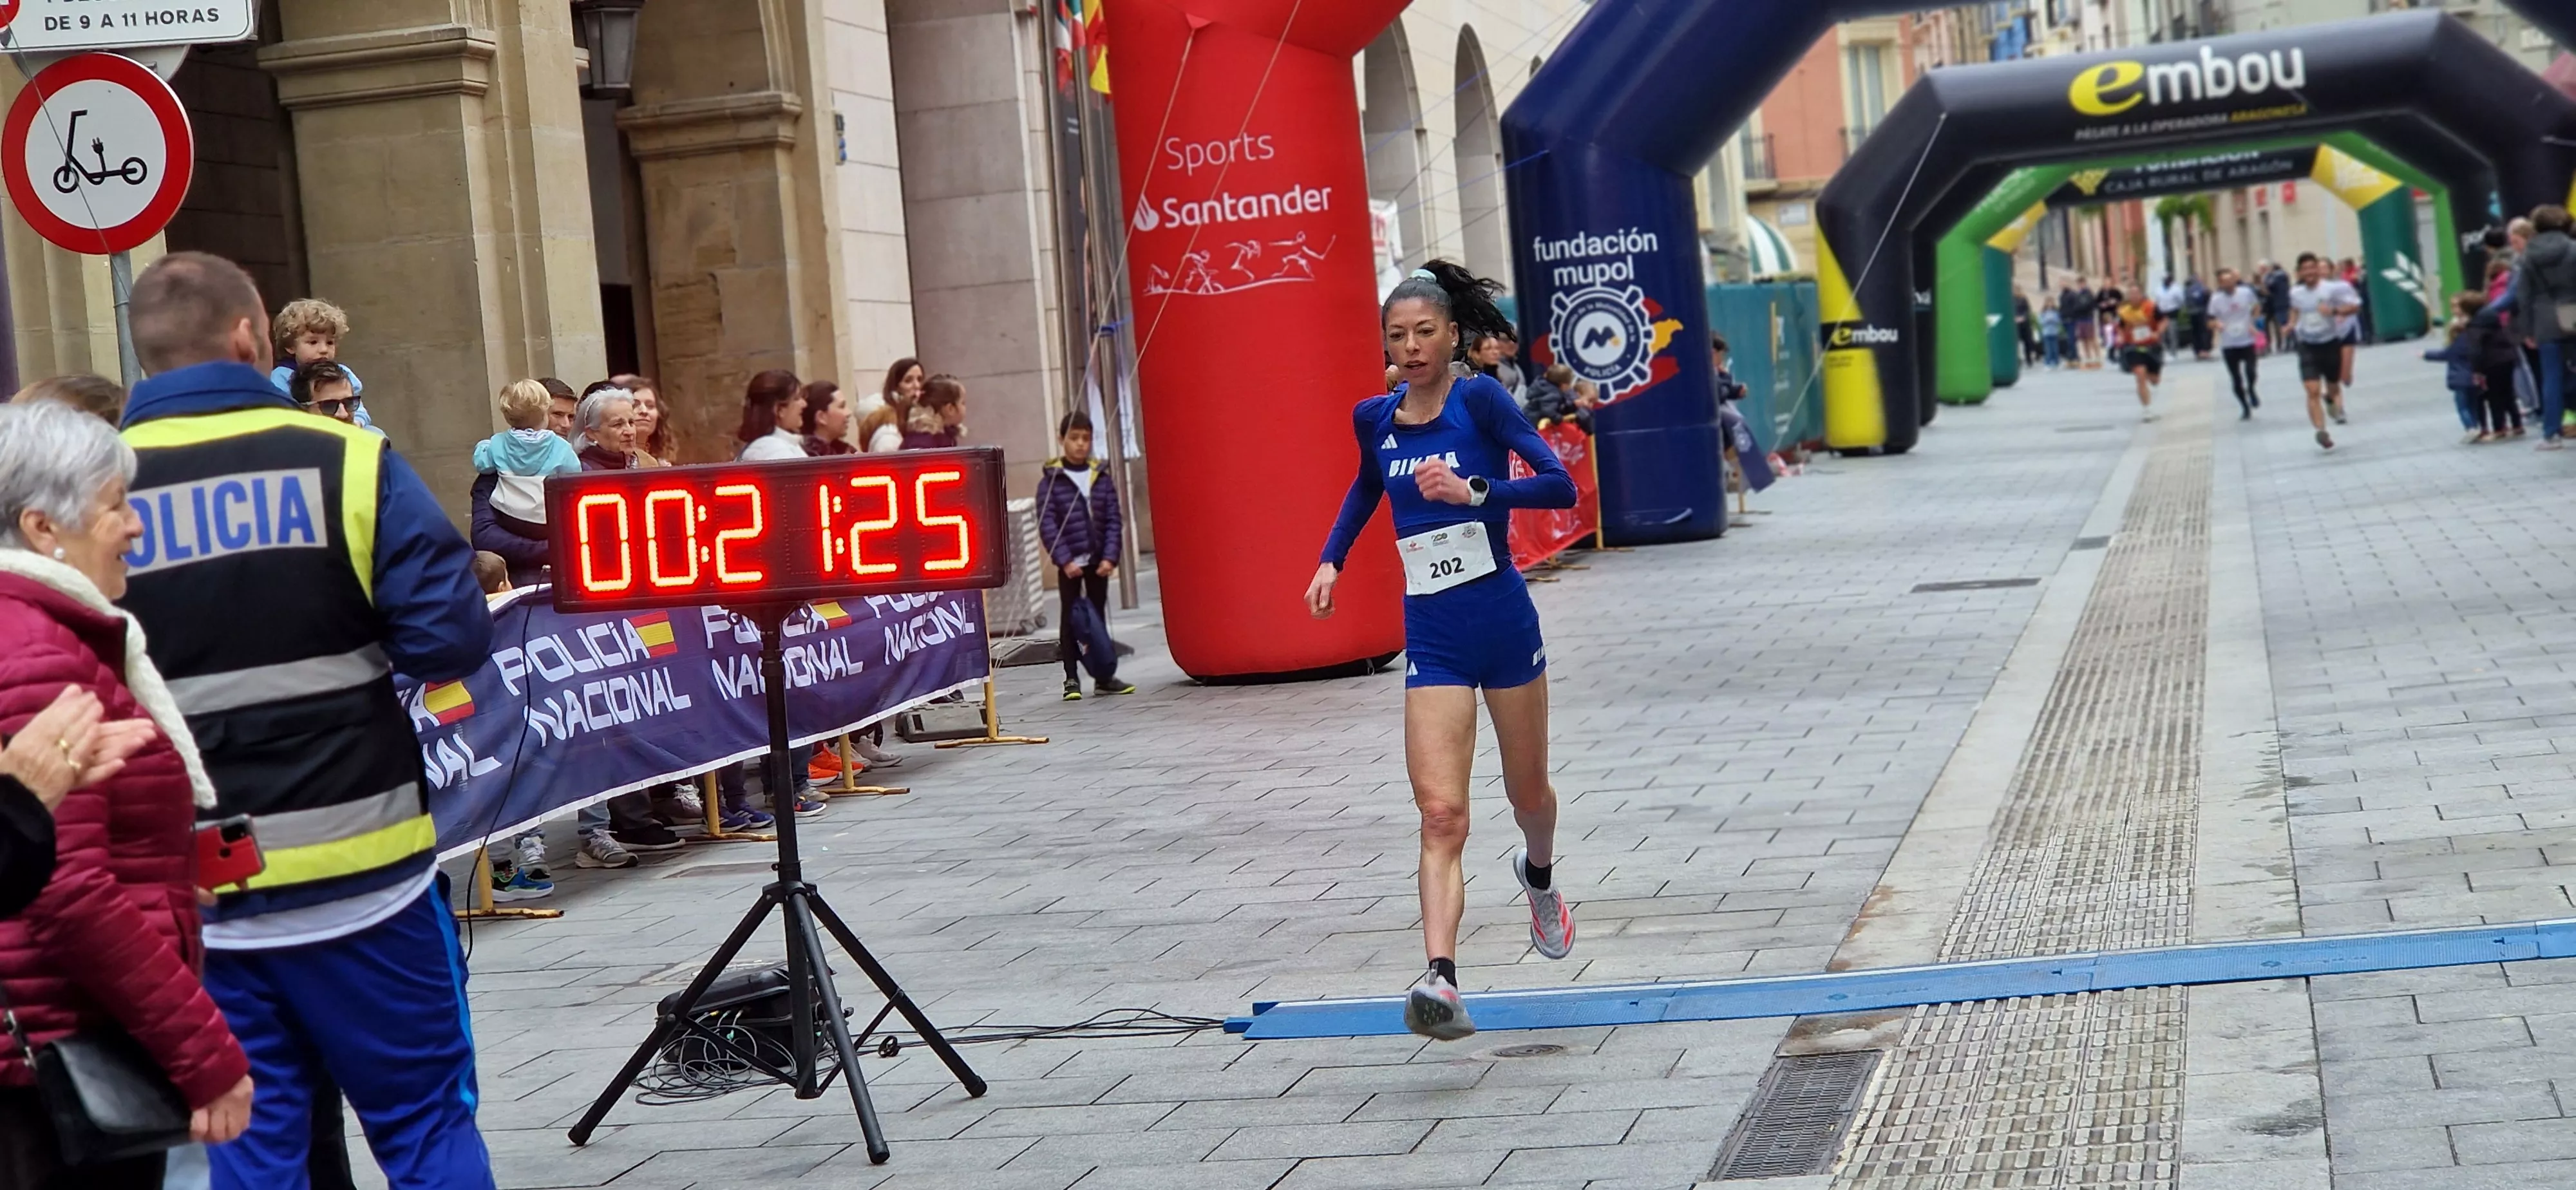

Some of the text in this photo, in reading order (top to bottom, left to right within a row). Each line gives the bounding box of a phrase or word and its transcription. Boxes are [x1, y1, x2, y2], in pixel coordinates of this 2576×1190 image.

[44, 8, 219, 31] DE 9 A 11 HORAS
[2069, 45, 2306, 117] embou
[1164, 132, 1274, 176] Sports
[1163, 184, 1331, 228] Santander
[1533, 227, 1658, 261] fundación
[1553, 256, 1634, 287] mupol
[1833, 324, 1899, 346] embou
[1389, 451, 1461, 477] BIKA
[124, 476, 316, 568] OLICIA
[1430, 557, 1464, 579] 202
[523, 666, 692, 747] NACIONAL
